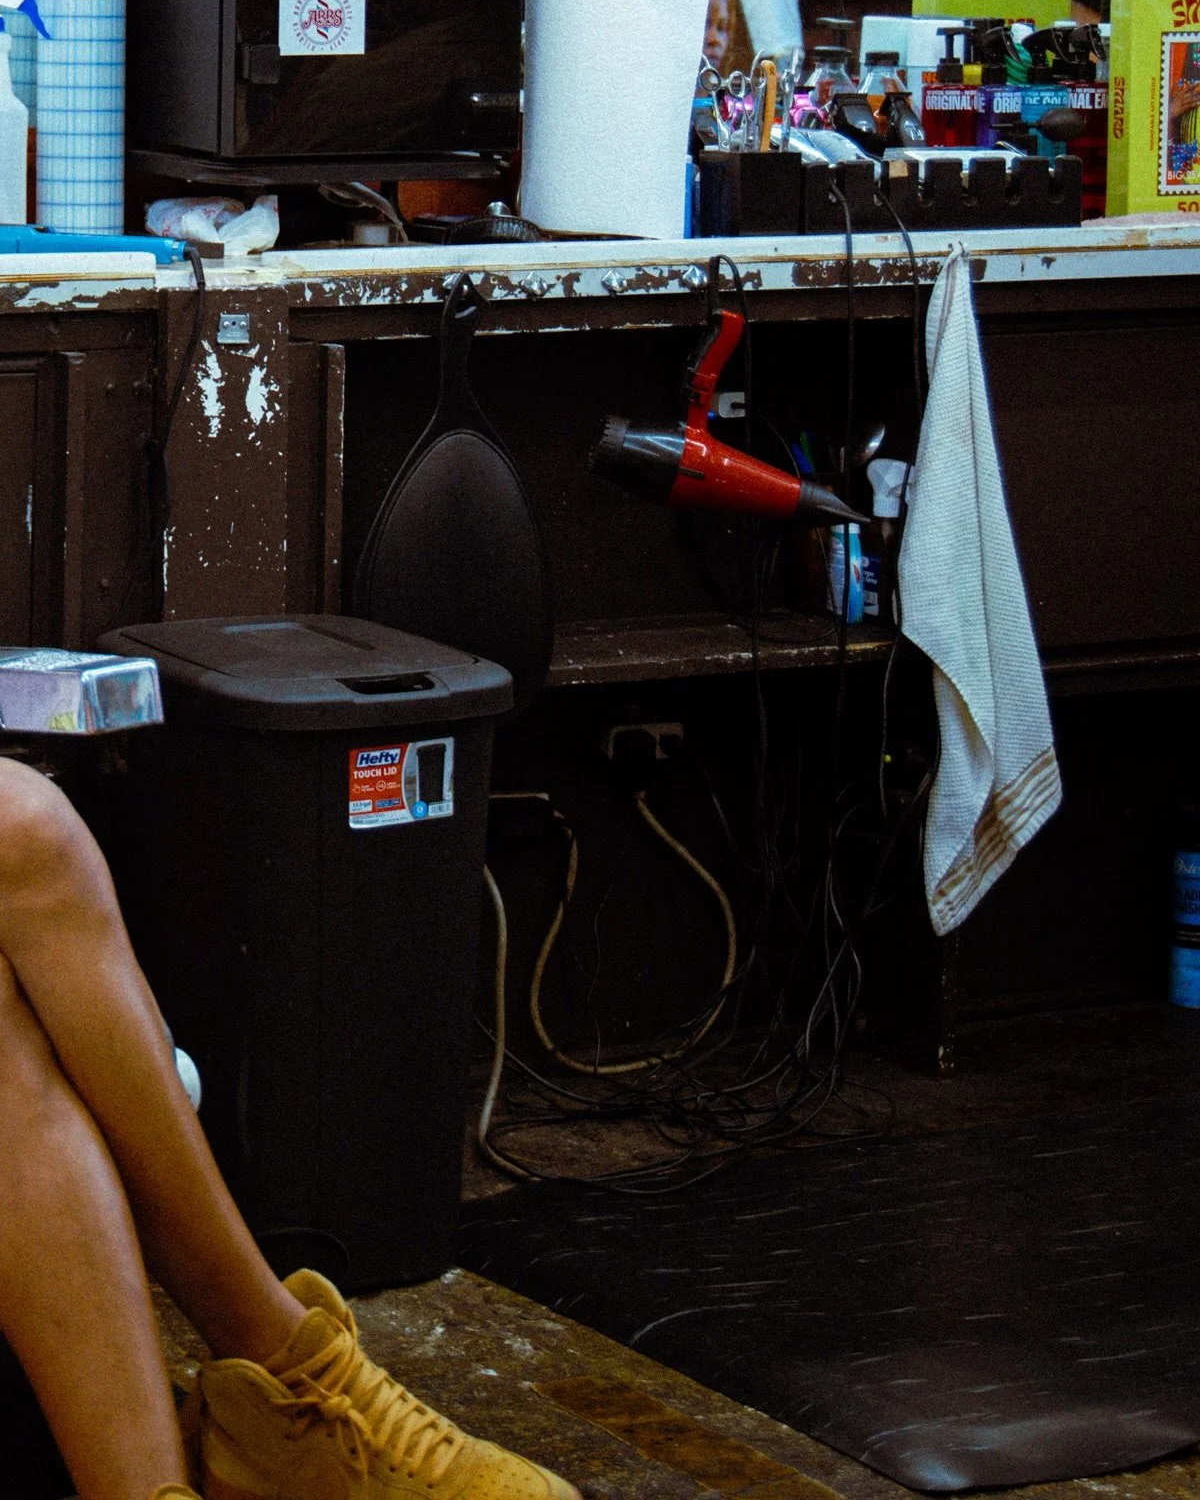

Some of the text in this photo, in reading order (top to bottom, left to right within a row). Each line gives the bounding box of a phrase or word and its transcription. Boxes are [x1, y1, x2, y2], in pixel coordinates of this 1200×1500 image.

[926, 94, 972, 110] ORIGINAL
[1167, 170, 1183, 181] BIG
[358, 751, 399, 765] Hefty
[353, 766, 398, 779] TOUCH LID
